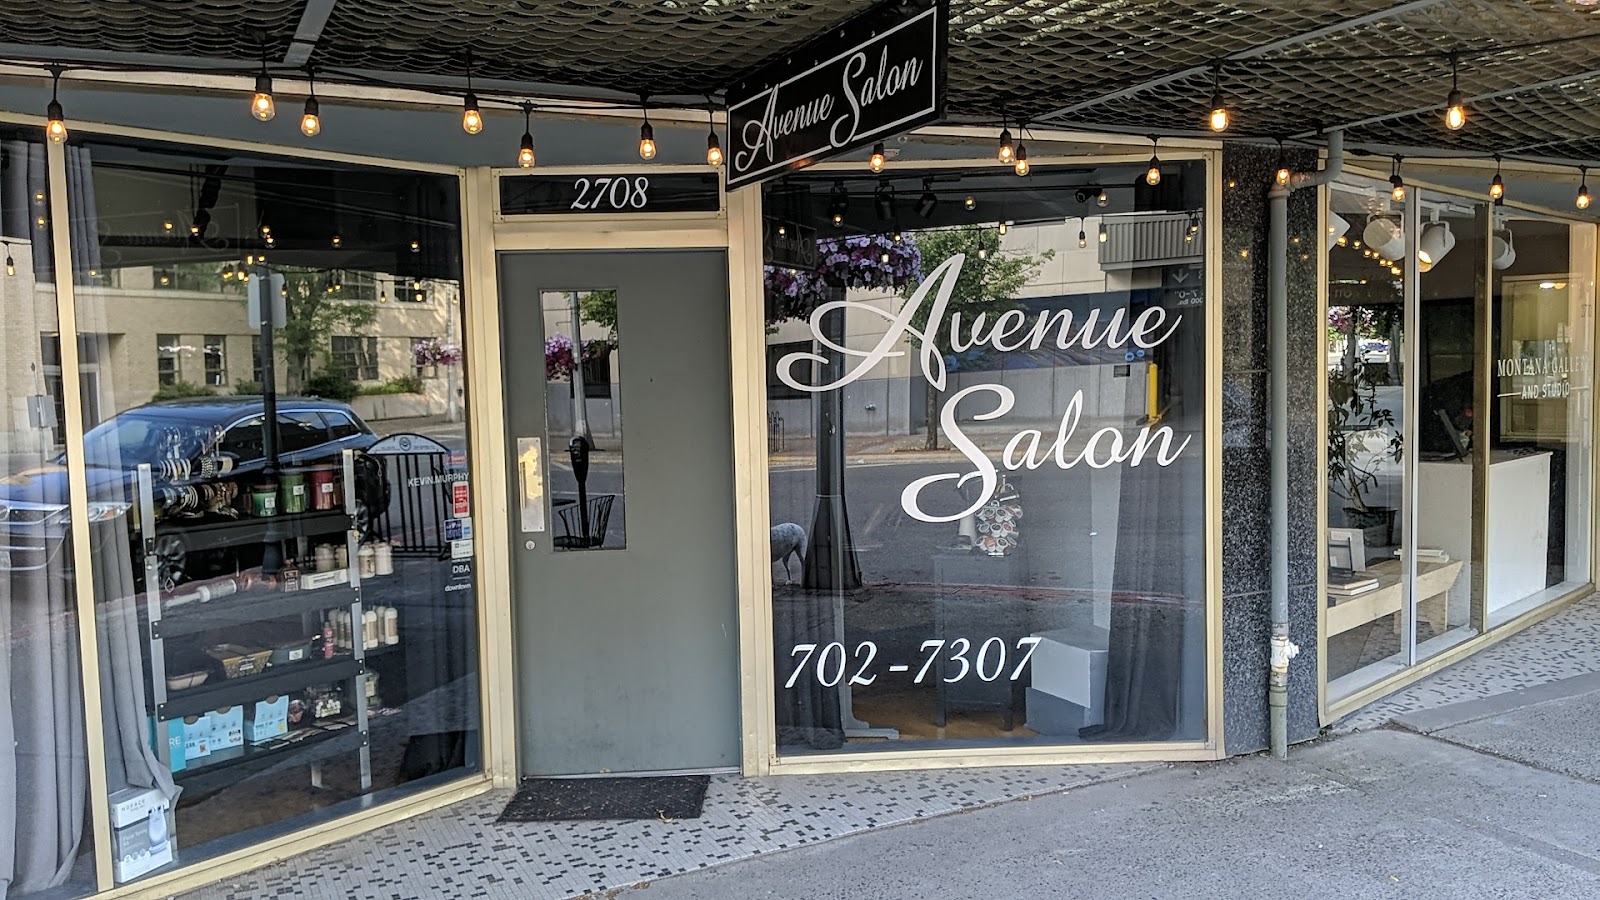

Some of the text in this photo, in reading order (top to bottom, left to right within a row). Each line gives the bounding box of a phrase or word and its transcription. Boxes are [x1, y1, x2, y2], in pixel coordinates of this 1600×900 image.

[735, 45, 923, 172] Avenue Salon
[570, 176, 649, 209] 2708
[775, 253, 1182, 392] Avenue
[1497, 357, 1548, 377] MONTANA
[1521, 382, 1570, 400] AND STUDIO
[901, 383, 1191, 523] Salon
[452, 564, 470, 574] DBA
[444, 583, 471, 592] downtown
